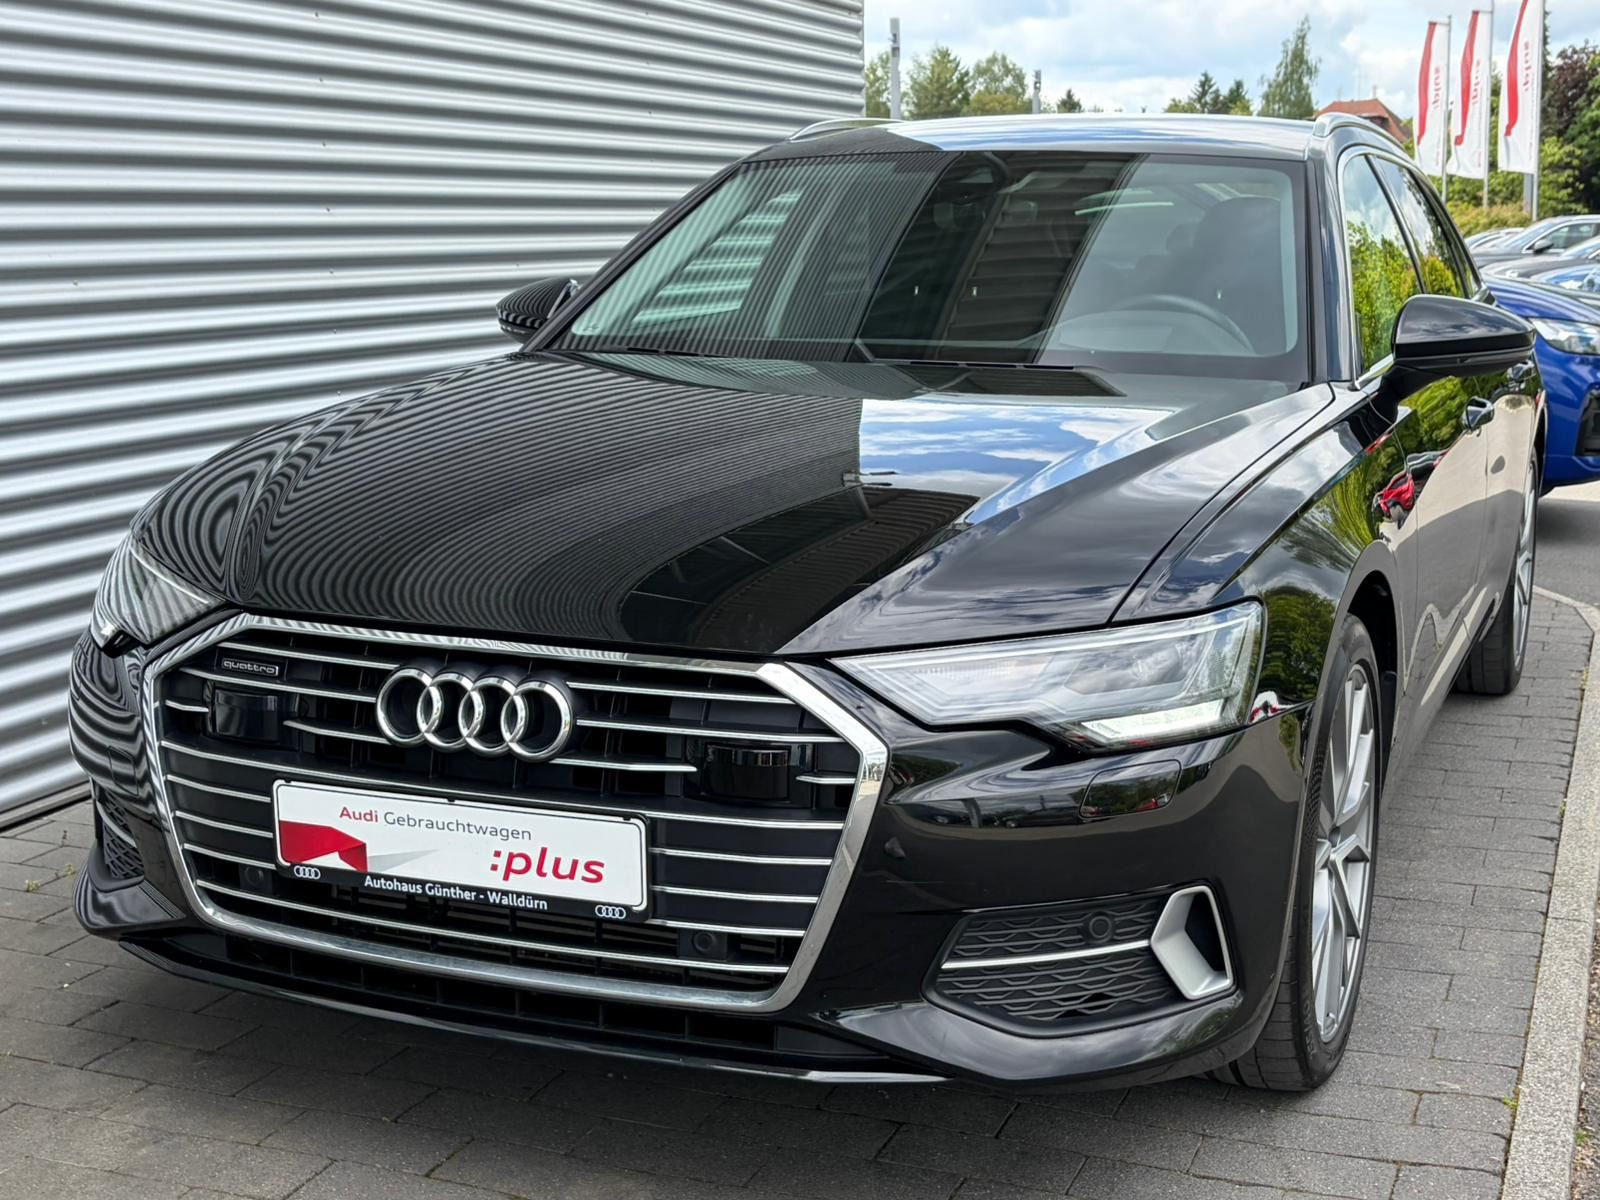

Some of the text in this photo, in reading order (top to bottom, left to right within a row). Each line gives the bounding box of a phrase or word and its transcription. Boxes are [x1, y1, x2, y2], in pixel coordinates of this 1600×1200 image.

[223, 660, 275, 674] quattro
[339, 806, 532, 842] Audi Gebrauchtwagen
[489, 847, 605, 884] :plus
[364, 875, 423, 894] Autohaus
[425, 882, 477, 901] Günther
[487, 890, 548, 911] Walldürn
